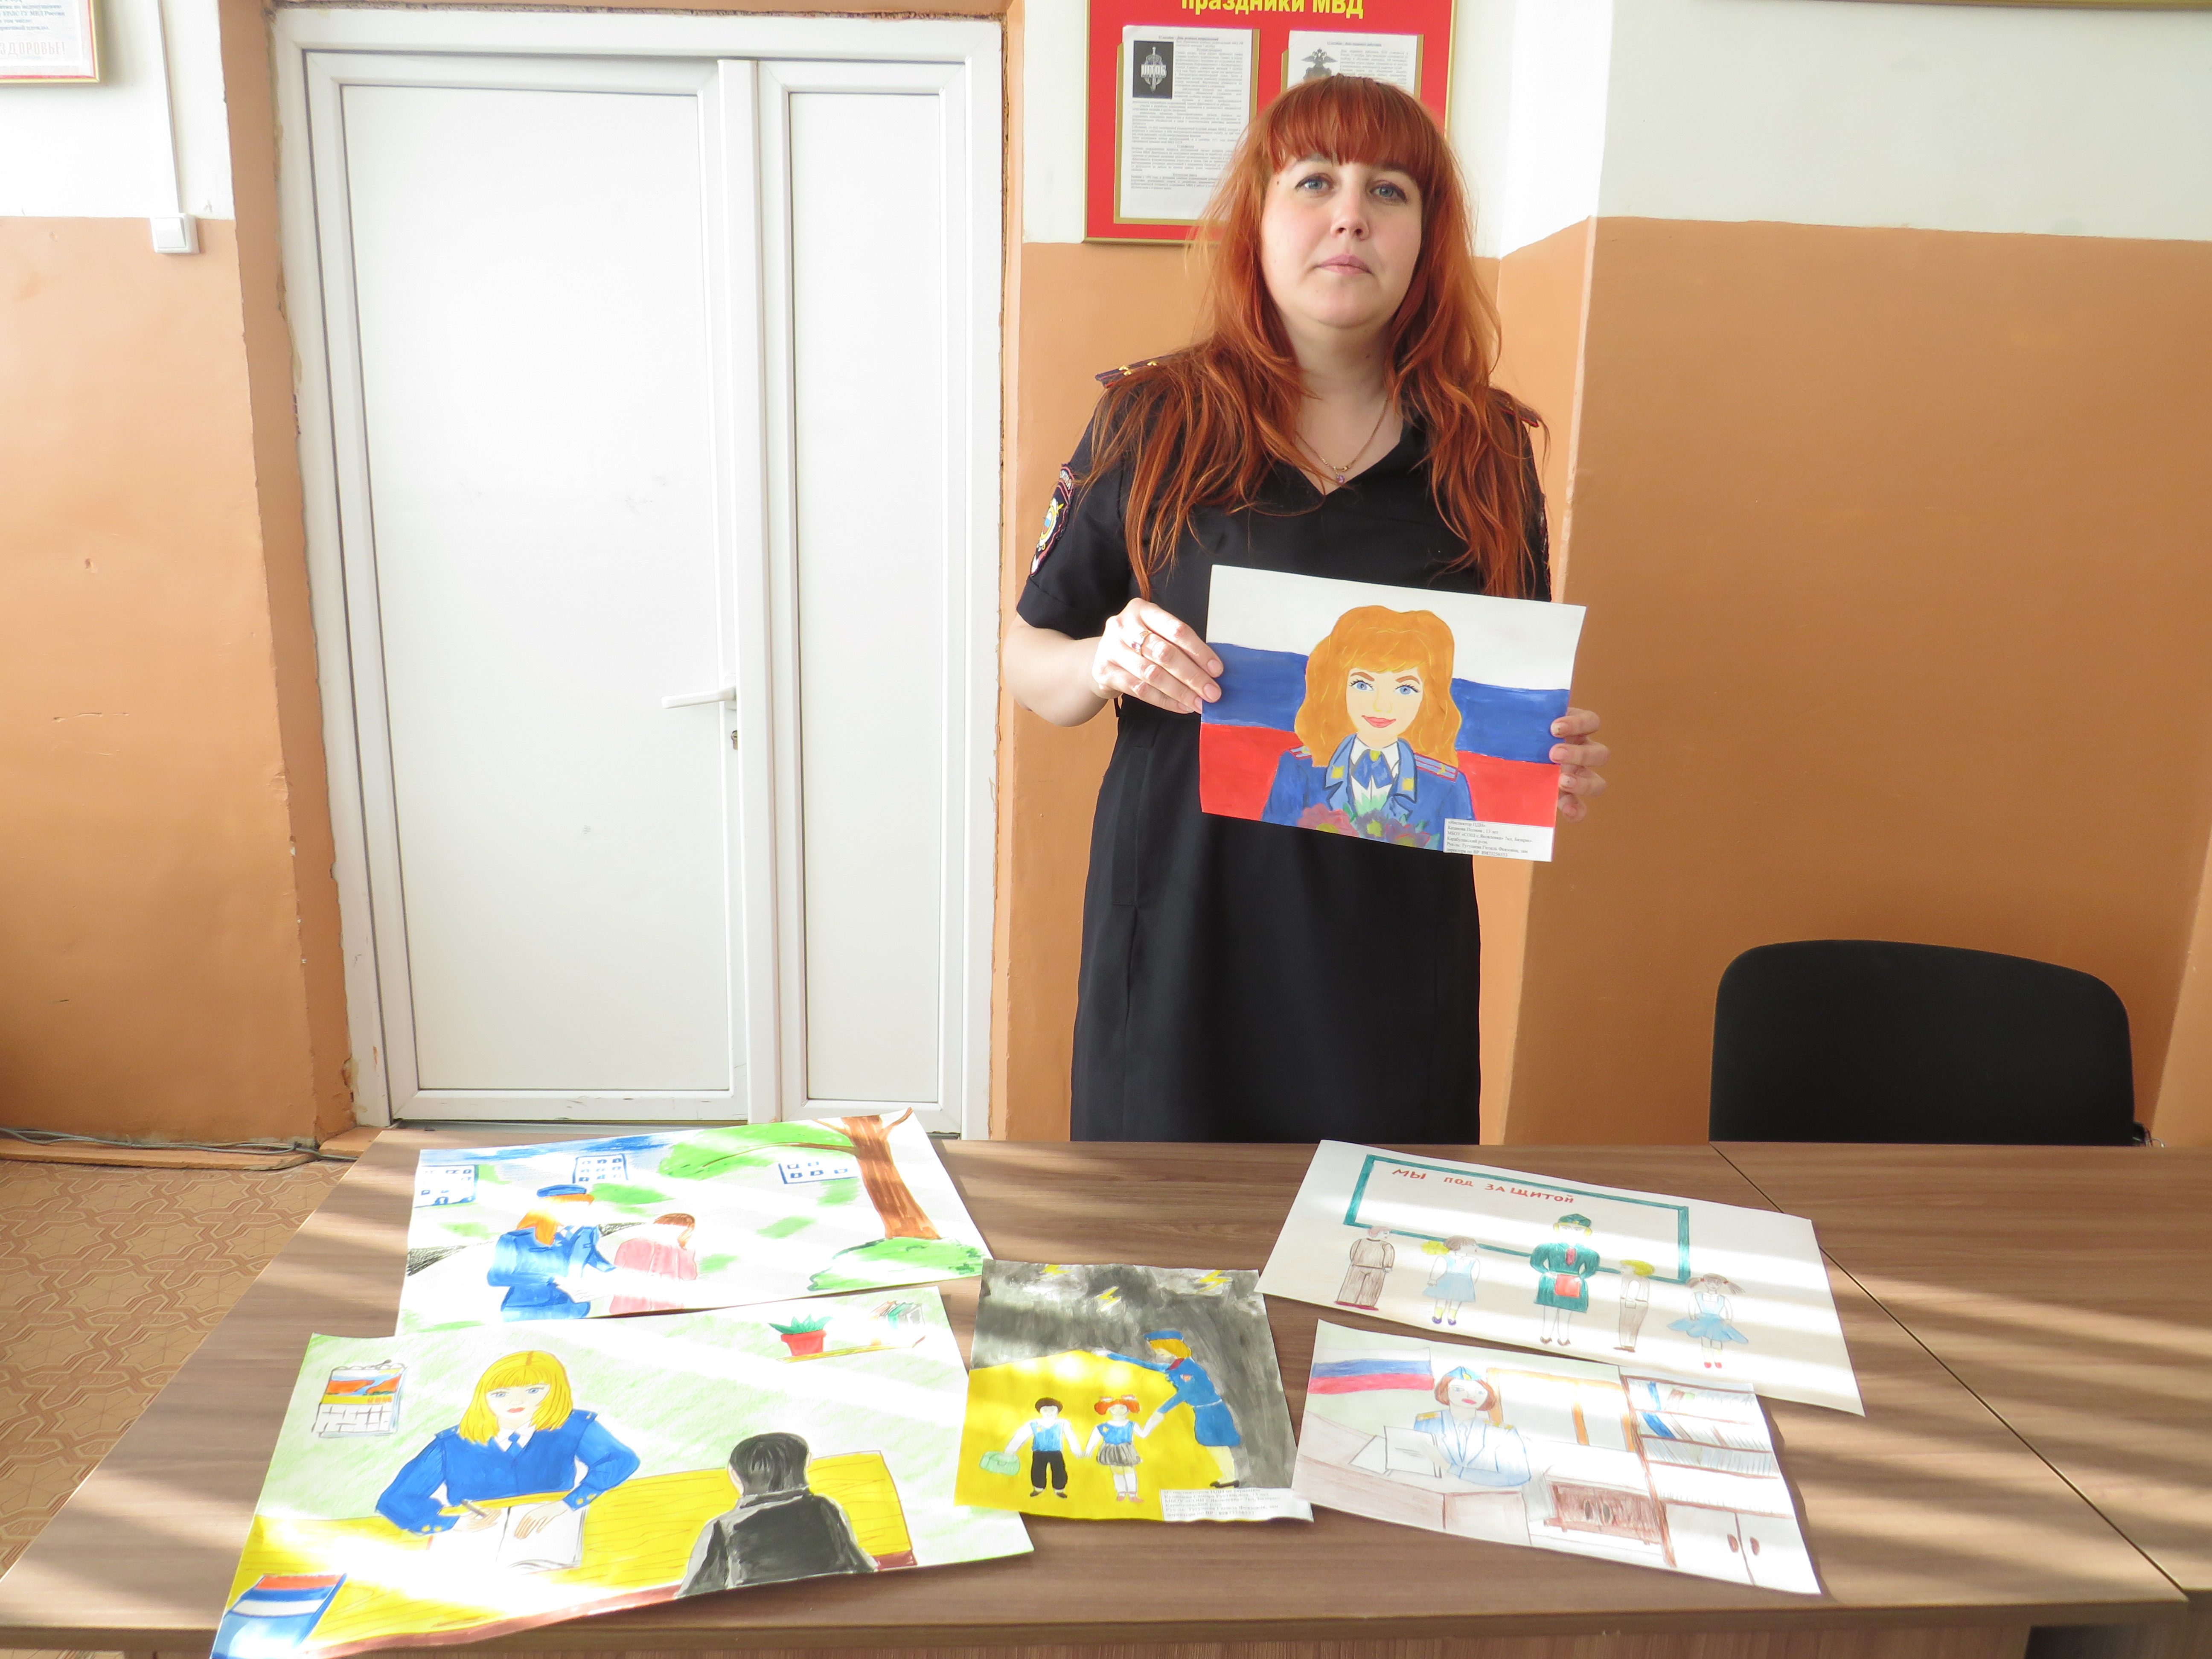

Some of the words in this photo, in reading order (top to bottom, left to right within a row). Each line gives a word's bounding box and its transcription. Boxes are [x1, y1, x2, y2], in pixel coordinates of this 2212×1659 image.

[1313, 0, 1364, 19] МВД
[0, 41, 65, 58] ЗДОРОВЬЕ!
[1392, 1169, 1426, 1180] МЫ
